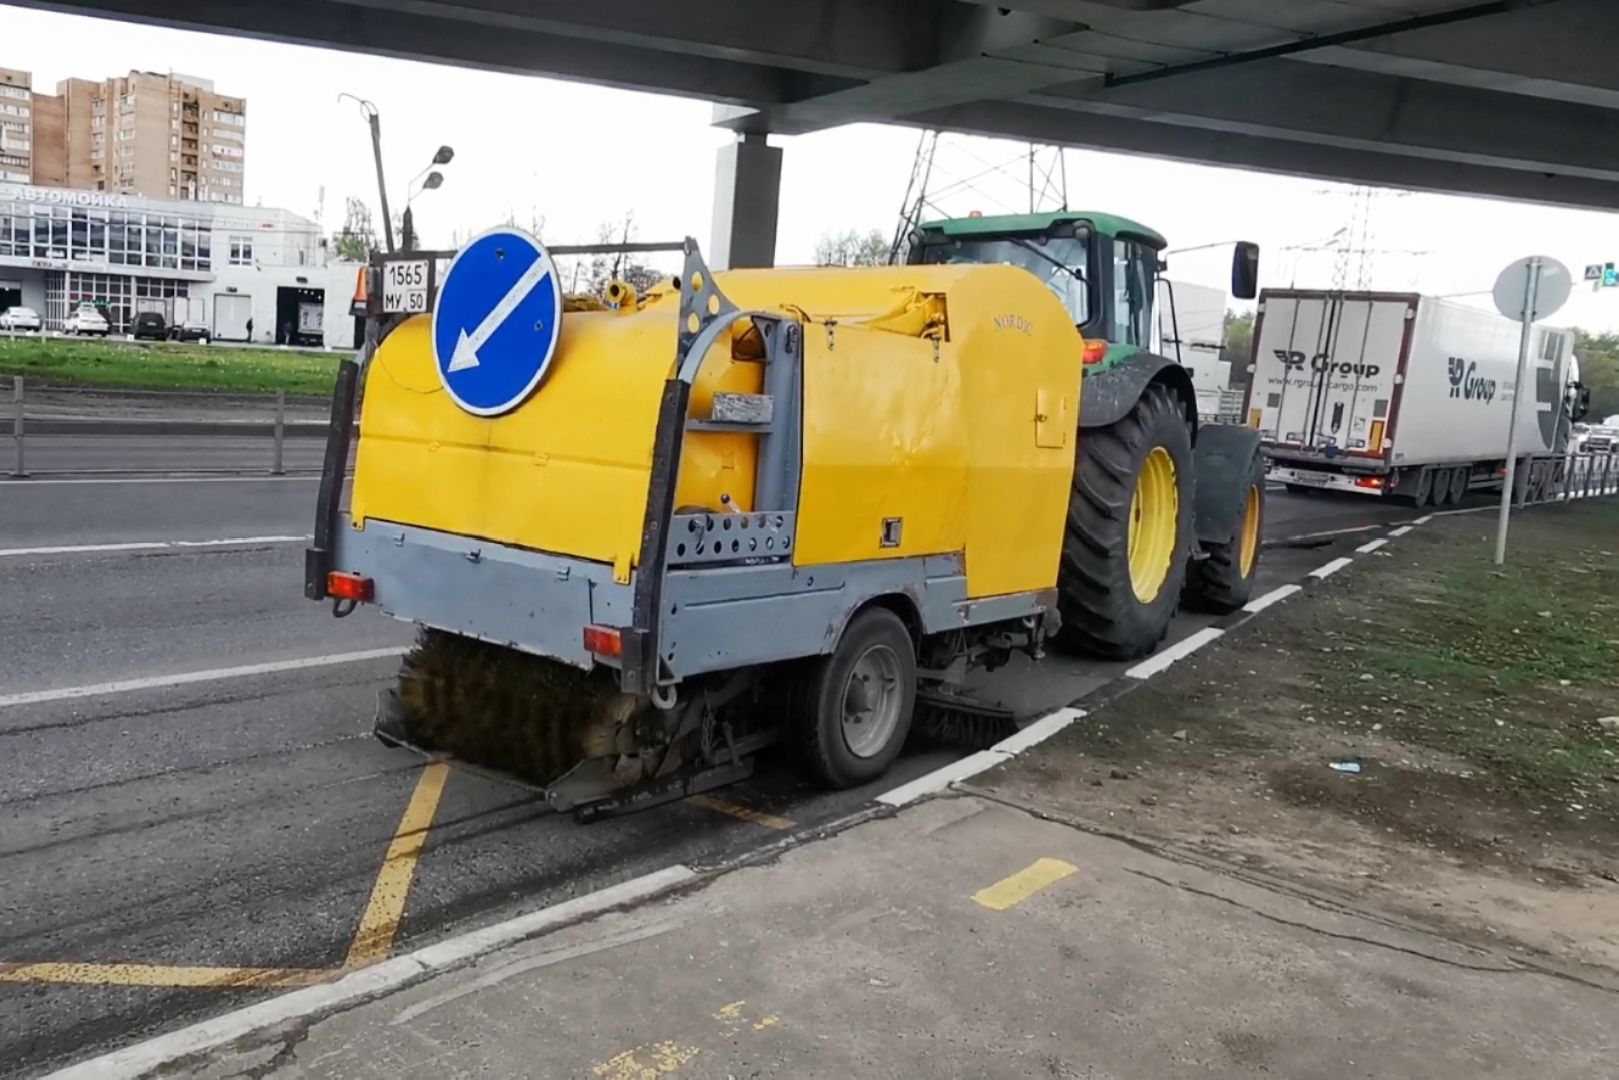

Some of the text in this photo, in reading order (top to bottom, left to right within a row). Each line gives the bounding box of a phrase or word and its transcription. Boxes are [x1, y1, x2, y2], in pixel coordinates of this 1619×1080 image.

[389, 265, 422, 285] 1565
[409, 293, 423, 309] 50
[1311, 353, 1380, 379] Group
[1464, 361, 1496, 405] Group
